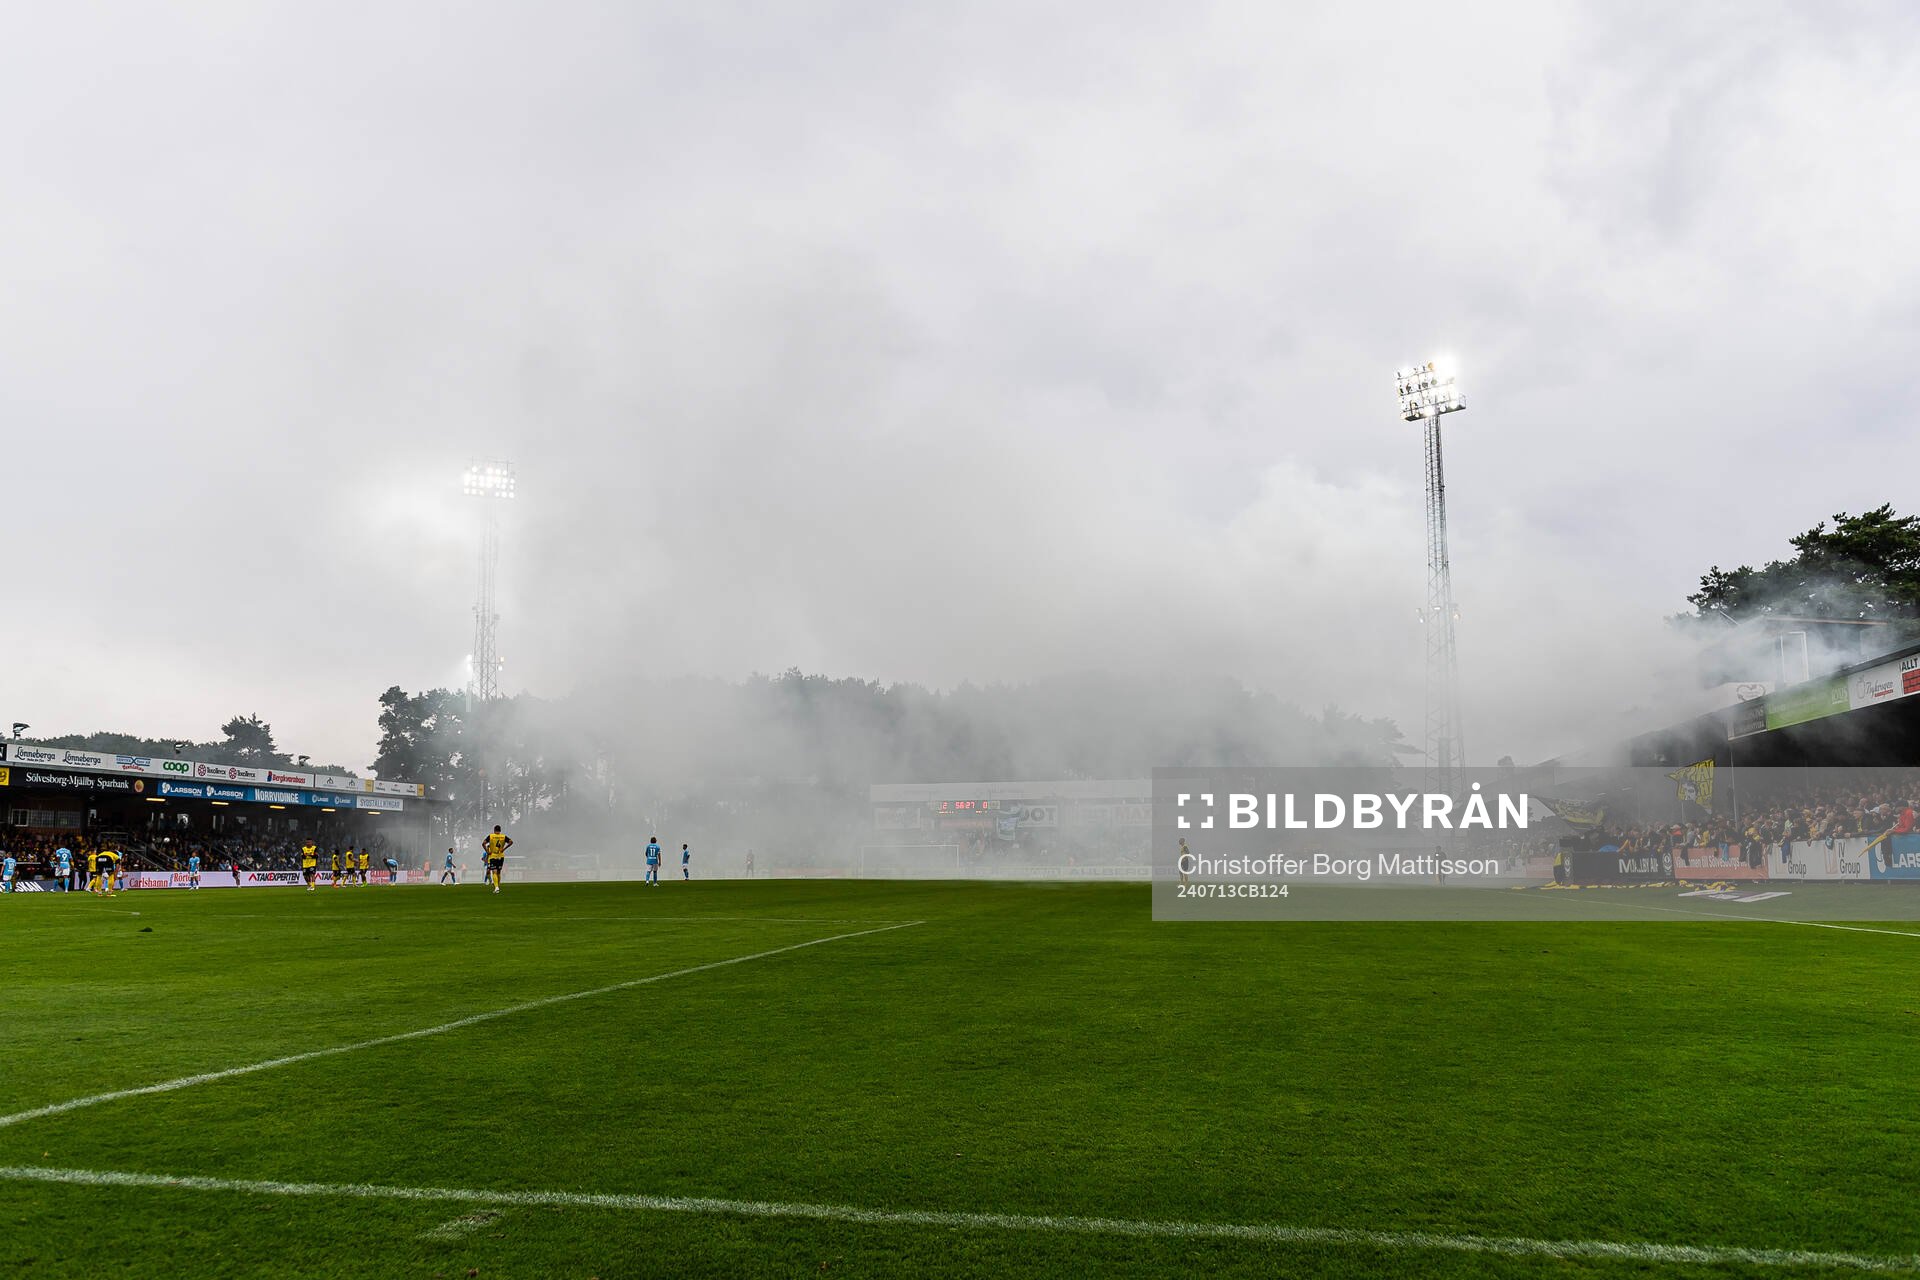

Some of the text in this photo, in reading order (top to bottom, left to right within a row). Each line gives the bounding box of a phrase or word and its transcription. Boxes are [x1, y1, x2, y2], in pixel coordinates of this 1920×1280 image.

[1901, 657, 1918, 672] ALLT
[14, 746, 56, 761] Lönneberga
[62, 751, 102, 765] Lönneberga
[163, 761, 189, 774] coop
[26, 771, 129, 790] Sölvesborg-Mjällby Sparbank
[170, 786, 202, 794] LARSSON
[254, 788, 300, 803] NORRVIDINGE
[61, 853, 68, 861] 9
[1787, 860, 1807, 878] Group
[1839, 859, 1861, 878] Group
